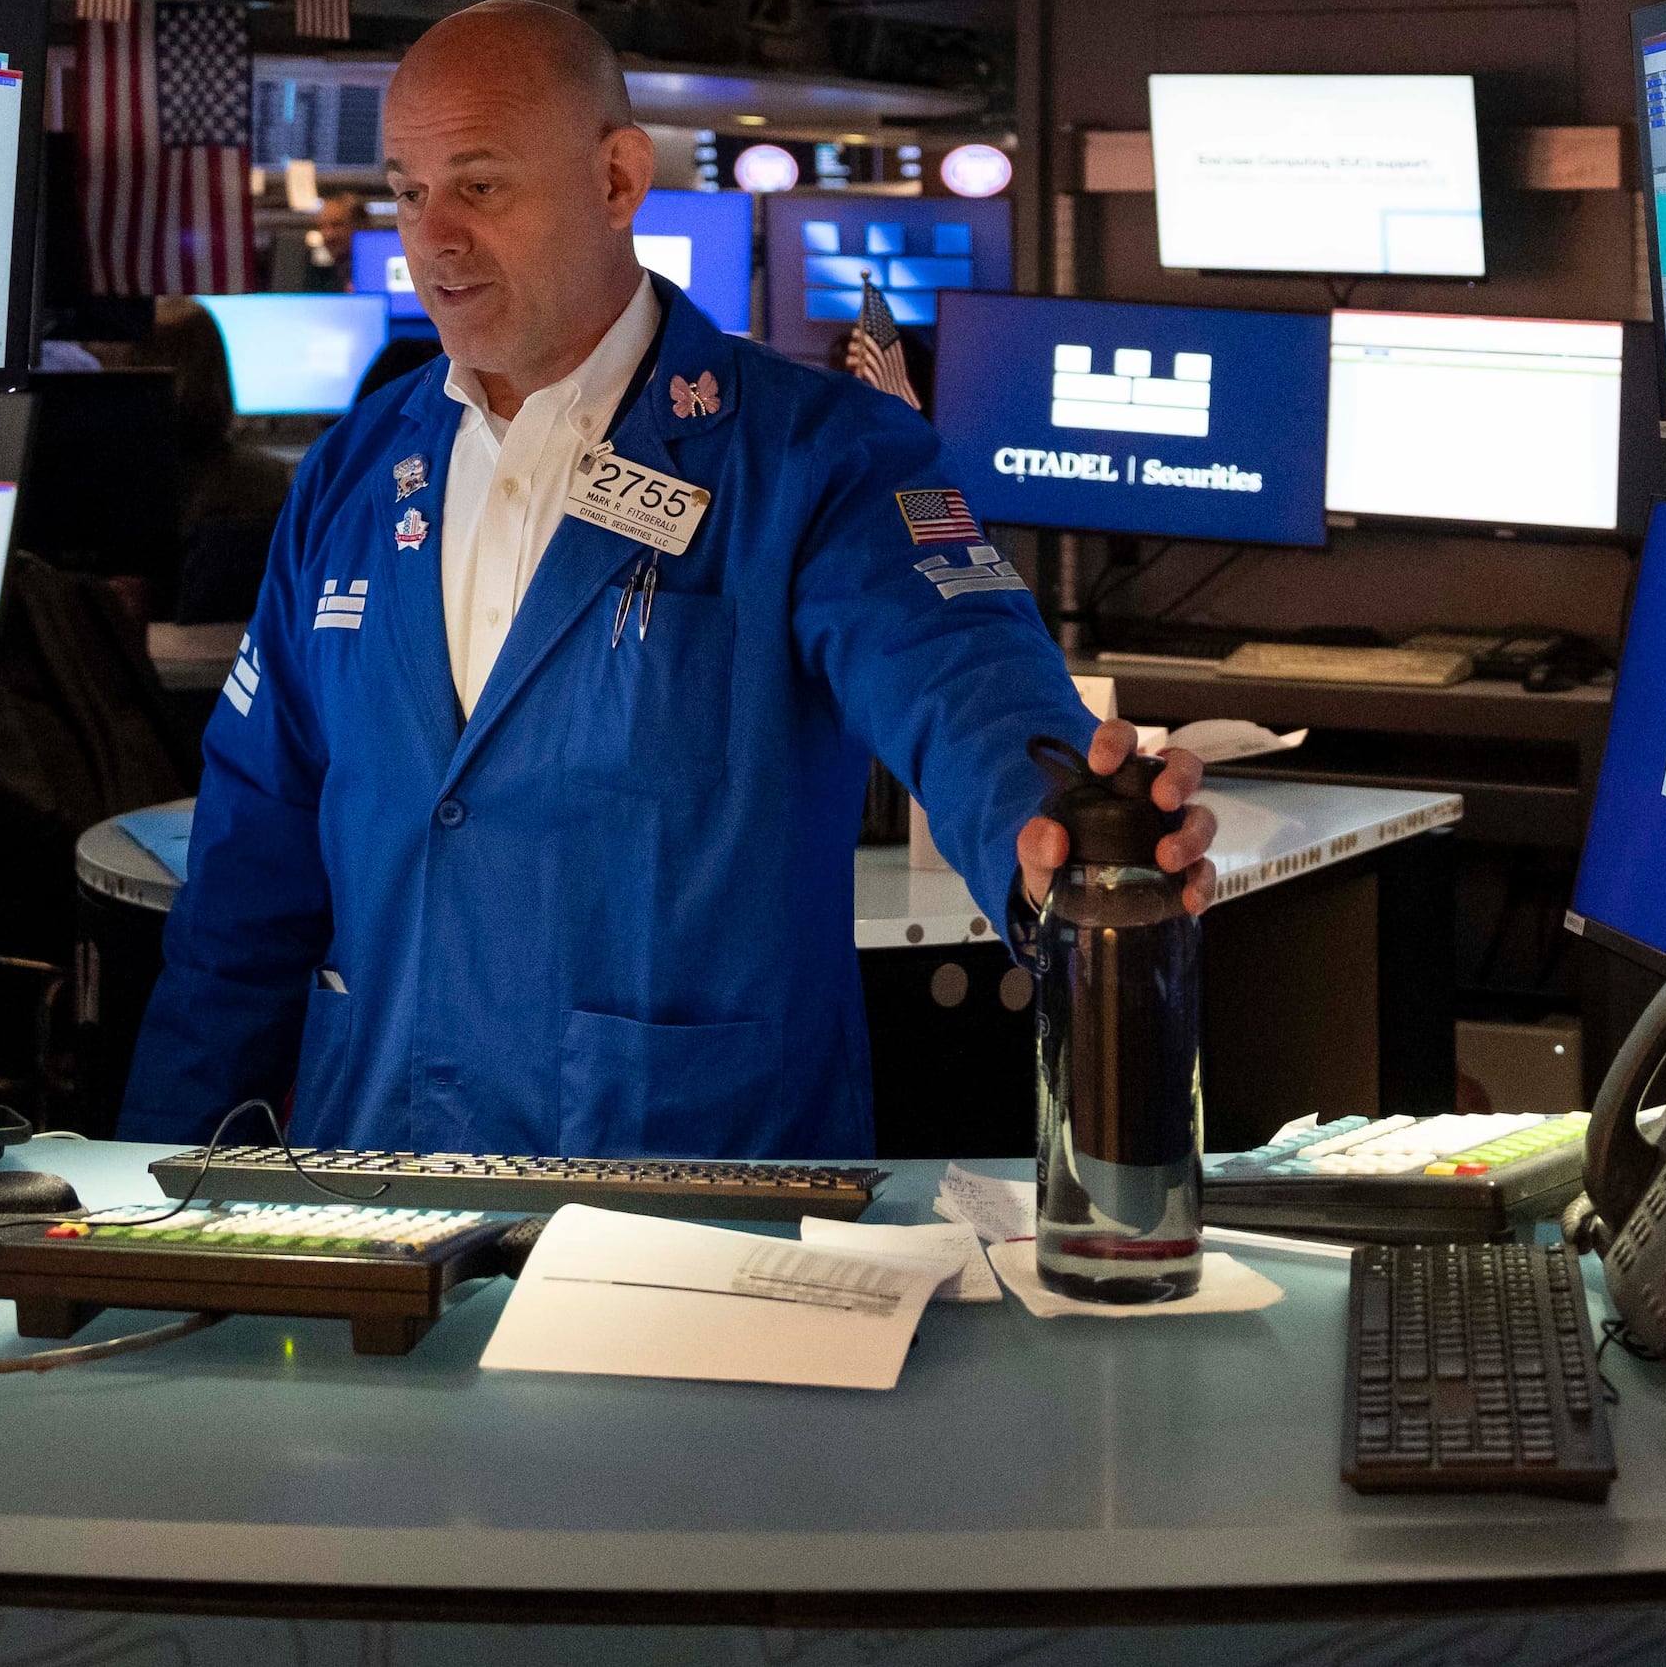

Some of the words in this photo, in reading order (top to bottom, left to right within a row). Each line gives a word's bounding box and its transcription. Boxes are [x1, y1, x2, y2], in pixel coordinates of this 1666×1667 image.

[592, 463, 691, 518] 2755
[995, 448, 1118, 481] CITADEL
[1142, 459, 1262, 492] Securities
[579, 507, 608, 524] CITADEL
[611, 520, 652, 540] SECURITIES
[655, 536, 668, 547] LLC
[585, 491, 611, 507] MARK
[614, 502, 622, 512] R.
[627, 508, 677, 533] FITZGERALD
